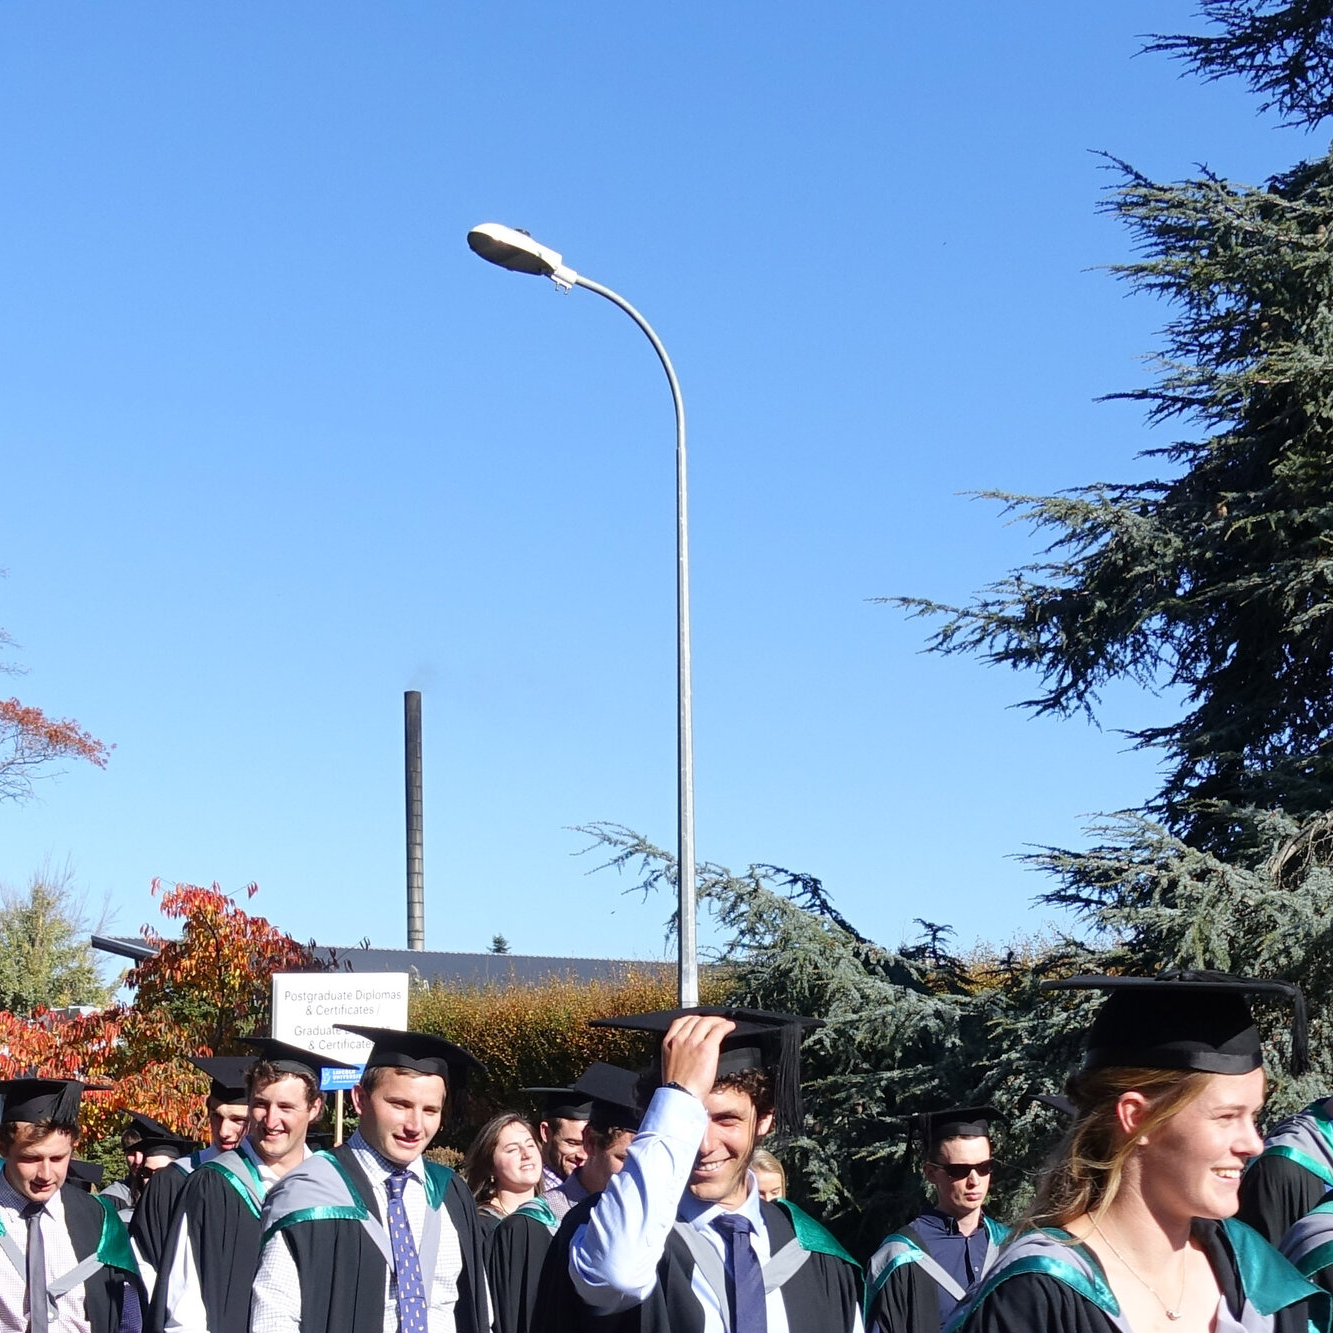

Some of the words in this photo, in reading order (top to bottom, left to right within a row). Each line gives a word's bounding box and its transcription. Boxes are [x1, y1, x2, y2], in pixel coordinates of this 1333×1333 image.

[284, 990, 353, 1003] Postgraduate
[355, 989, 402, 1003] Diplomas
[305, 1005, 313, 1016] &
[315, 1004, 375, 1015] Certificates
[294, 1025, 342, 1036] Graduate
[308, 1040, 315, 1050] &
